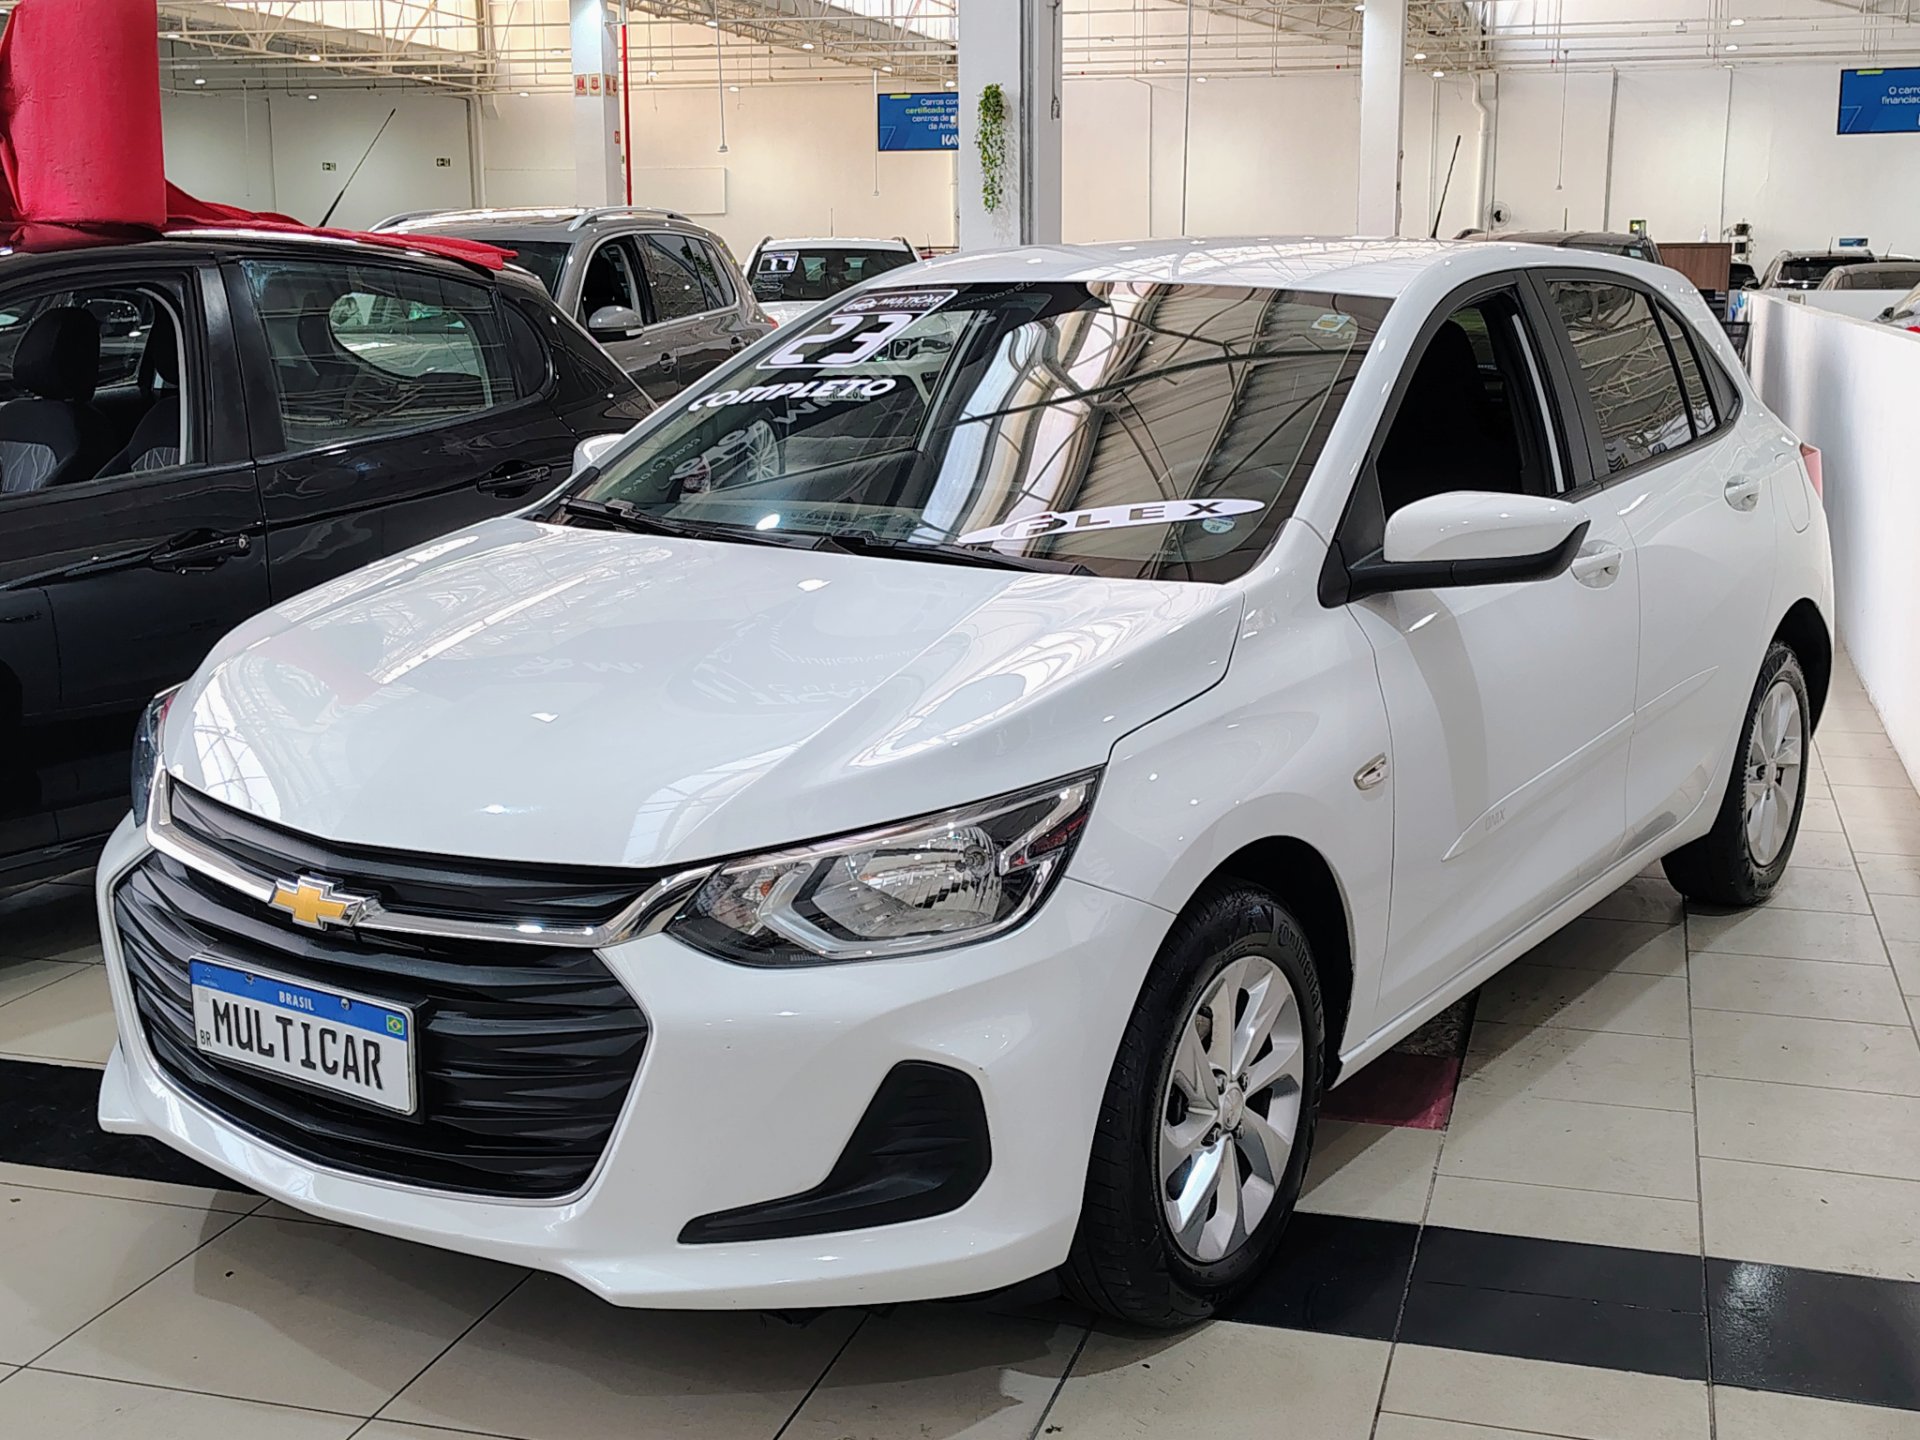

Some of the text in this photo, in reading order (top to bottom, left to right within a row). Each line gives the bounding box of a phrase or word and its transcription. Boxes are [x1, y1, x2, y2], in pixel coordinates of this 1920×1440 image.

[920, 98, 944, 106] Carros
[1888, 86, 1897, 95] O
[769, 313, 913, 365] 23
[688, 378, 897, 412] COMPLETO
[1013, 501, 1223, 538] FLEX
[278, 990, 315, 1012] BRASIL
[199, 1029, 212, 1047] BR
[211, 998, 384, 1091] MULTICAR
